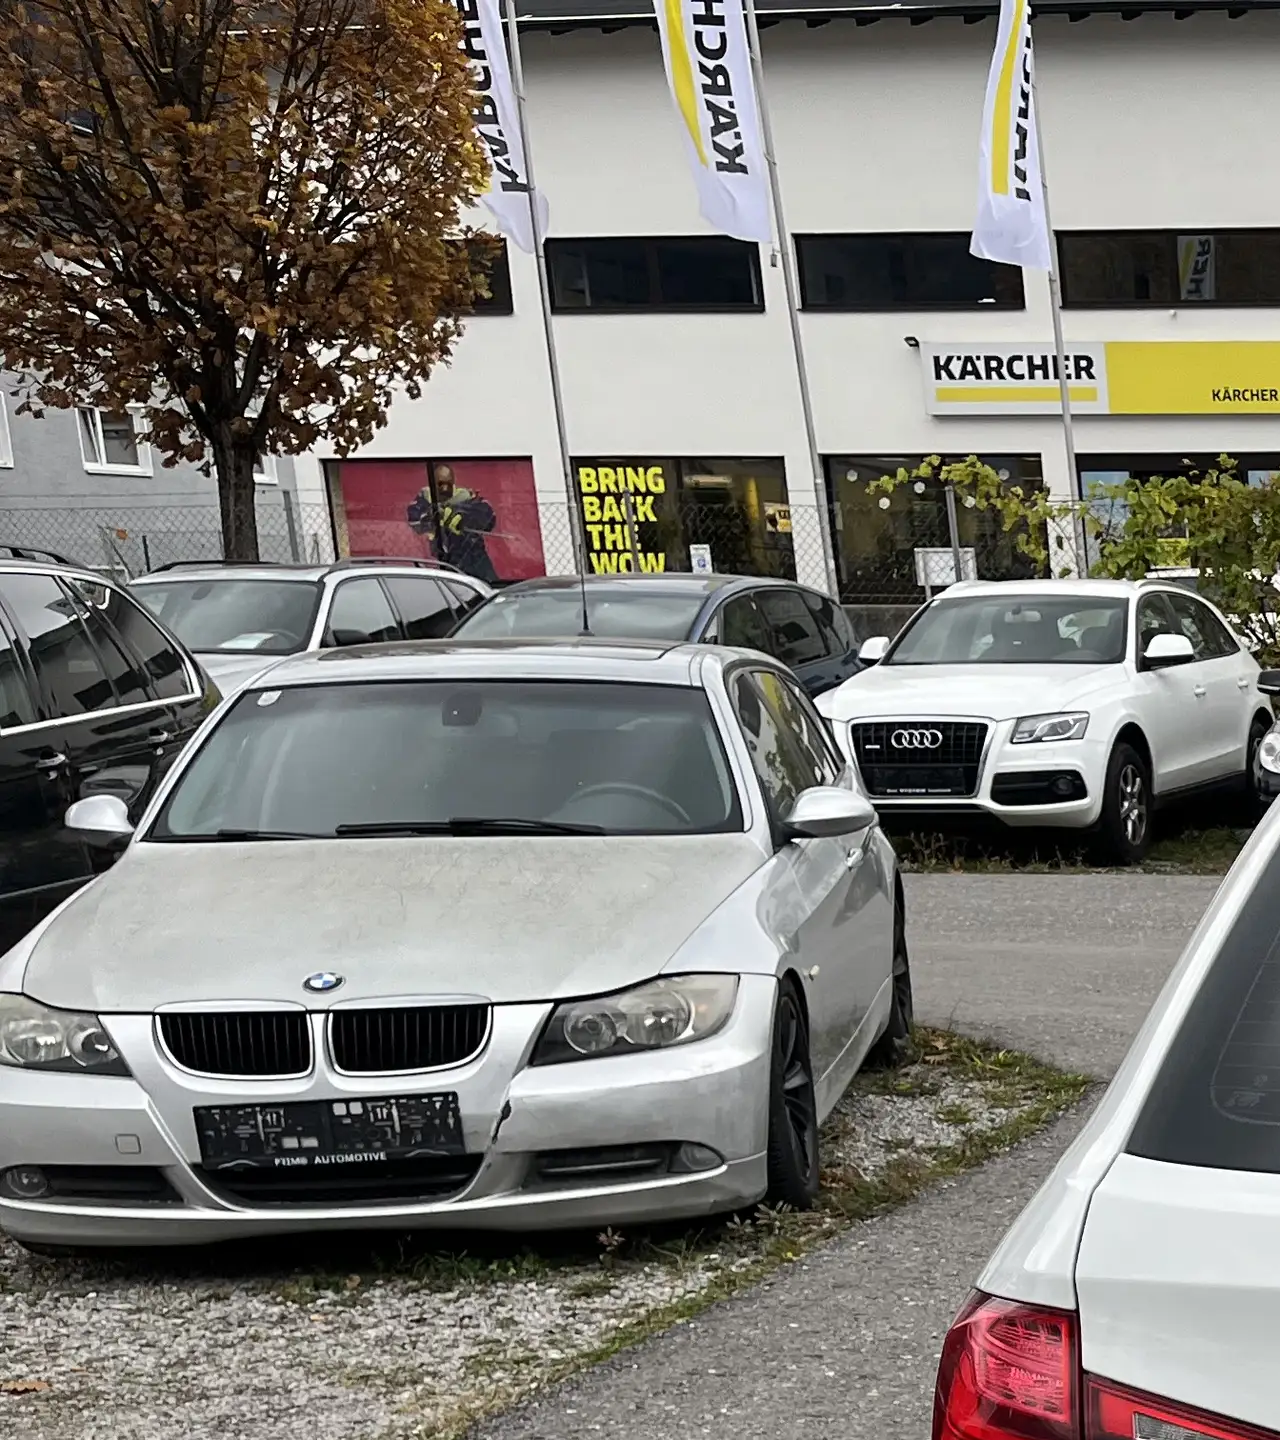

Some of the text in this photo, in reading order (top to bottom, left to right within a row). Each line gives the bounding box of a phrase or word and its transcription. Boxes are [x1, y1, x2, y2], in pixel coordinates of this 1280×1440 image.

[933, 355, 1097, 381] KÄRCHER
[1212, 387, 1278, 402] KÄRCHER
[578, 466, 666, 494] BRING
[588, 552, 666, 576] WOW
[314, 1151, 388, 1165] AUTOMOTIVE
